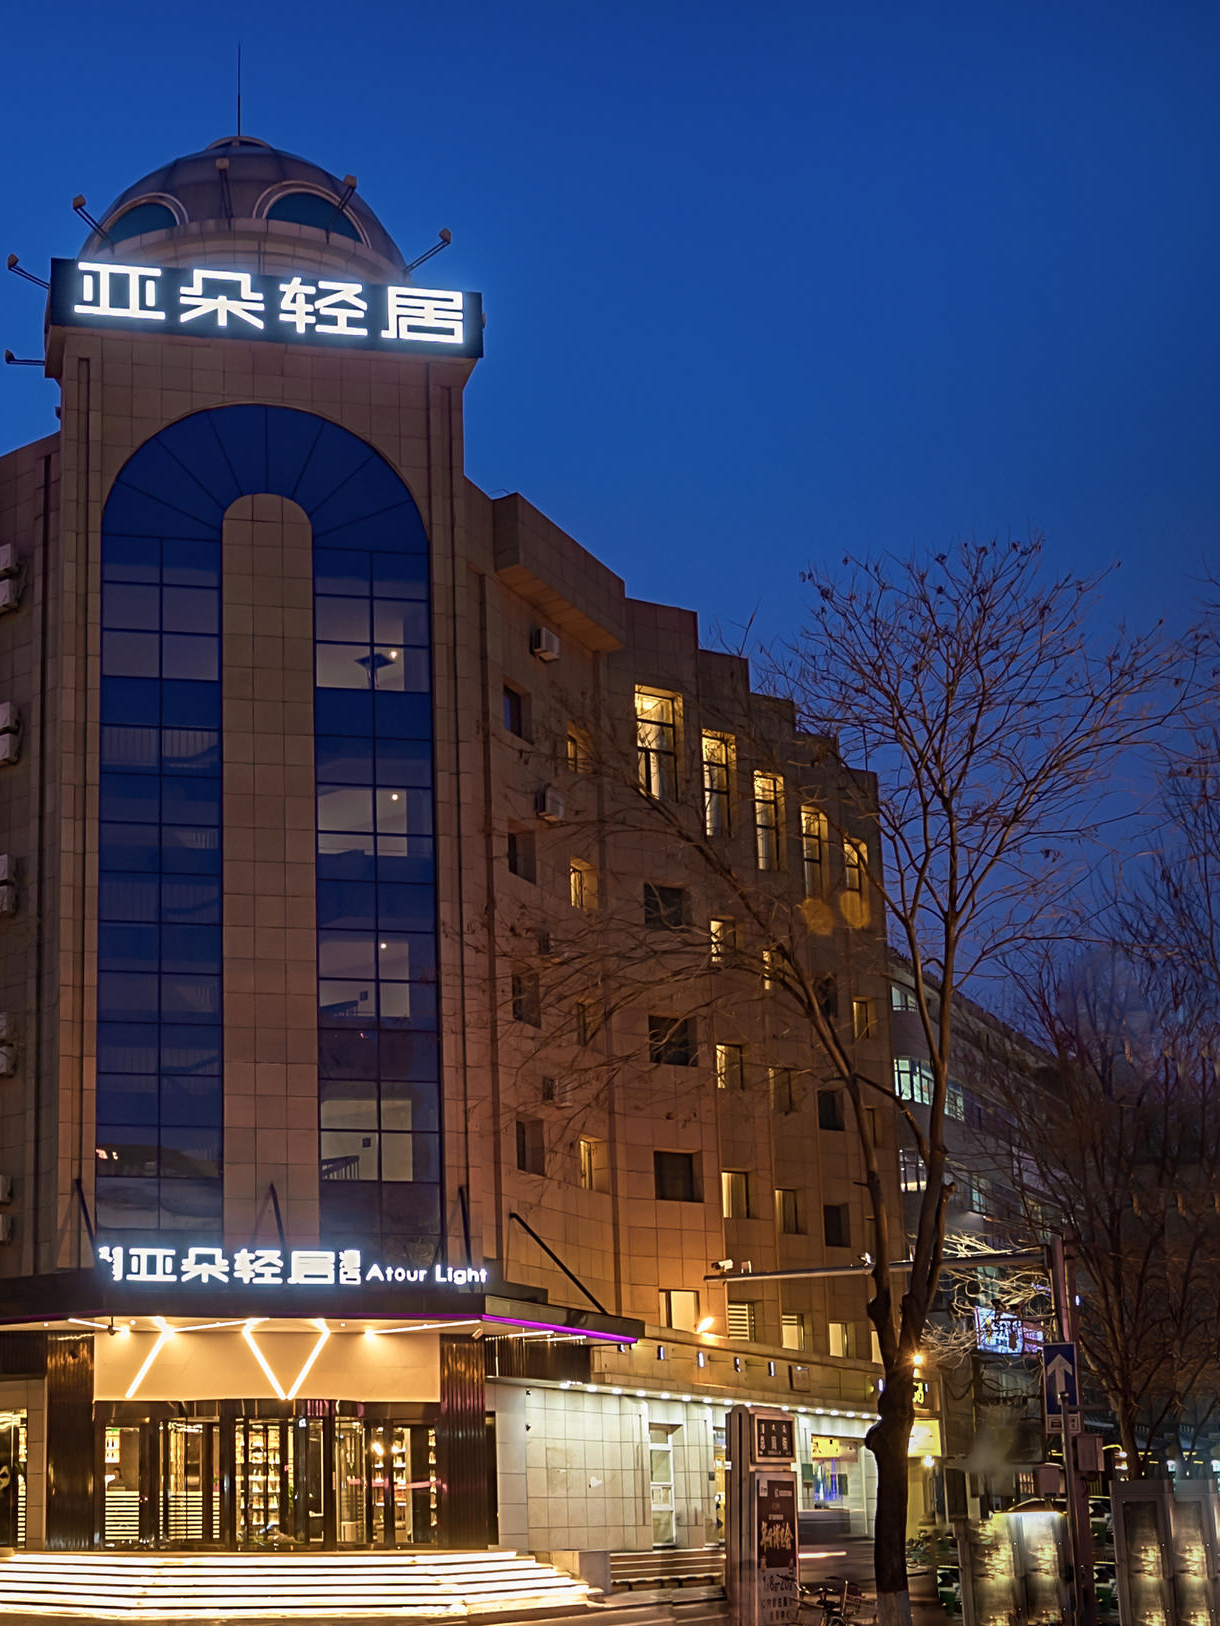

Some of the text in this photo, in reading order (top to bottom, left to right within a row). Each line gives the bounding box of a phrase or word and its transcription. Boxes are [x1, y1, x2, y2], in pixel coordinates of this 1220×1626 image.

[73, 261, 464, 344] 亚朵轻居
[366, 1262, 426, 1284] Atour
[435, 1264, 488, 1285] Light
